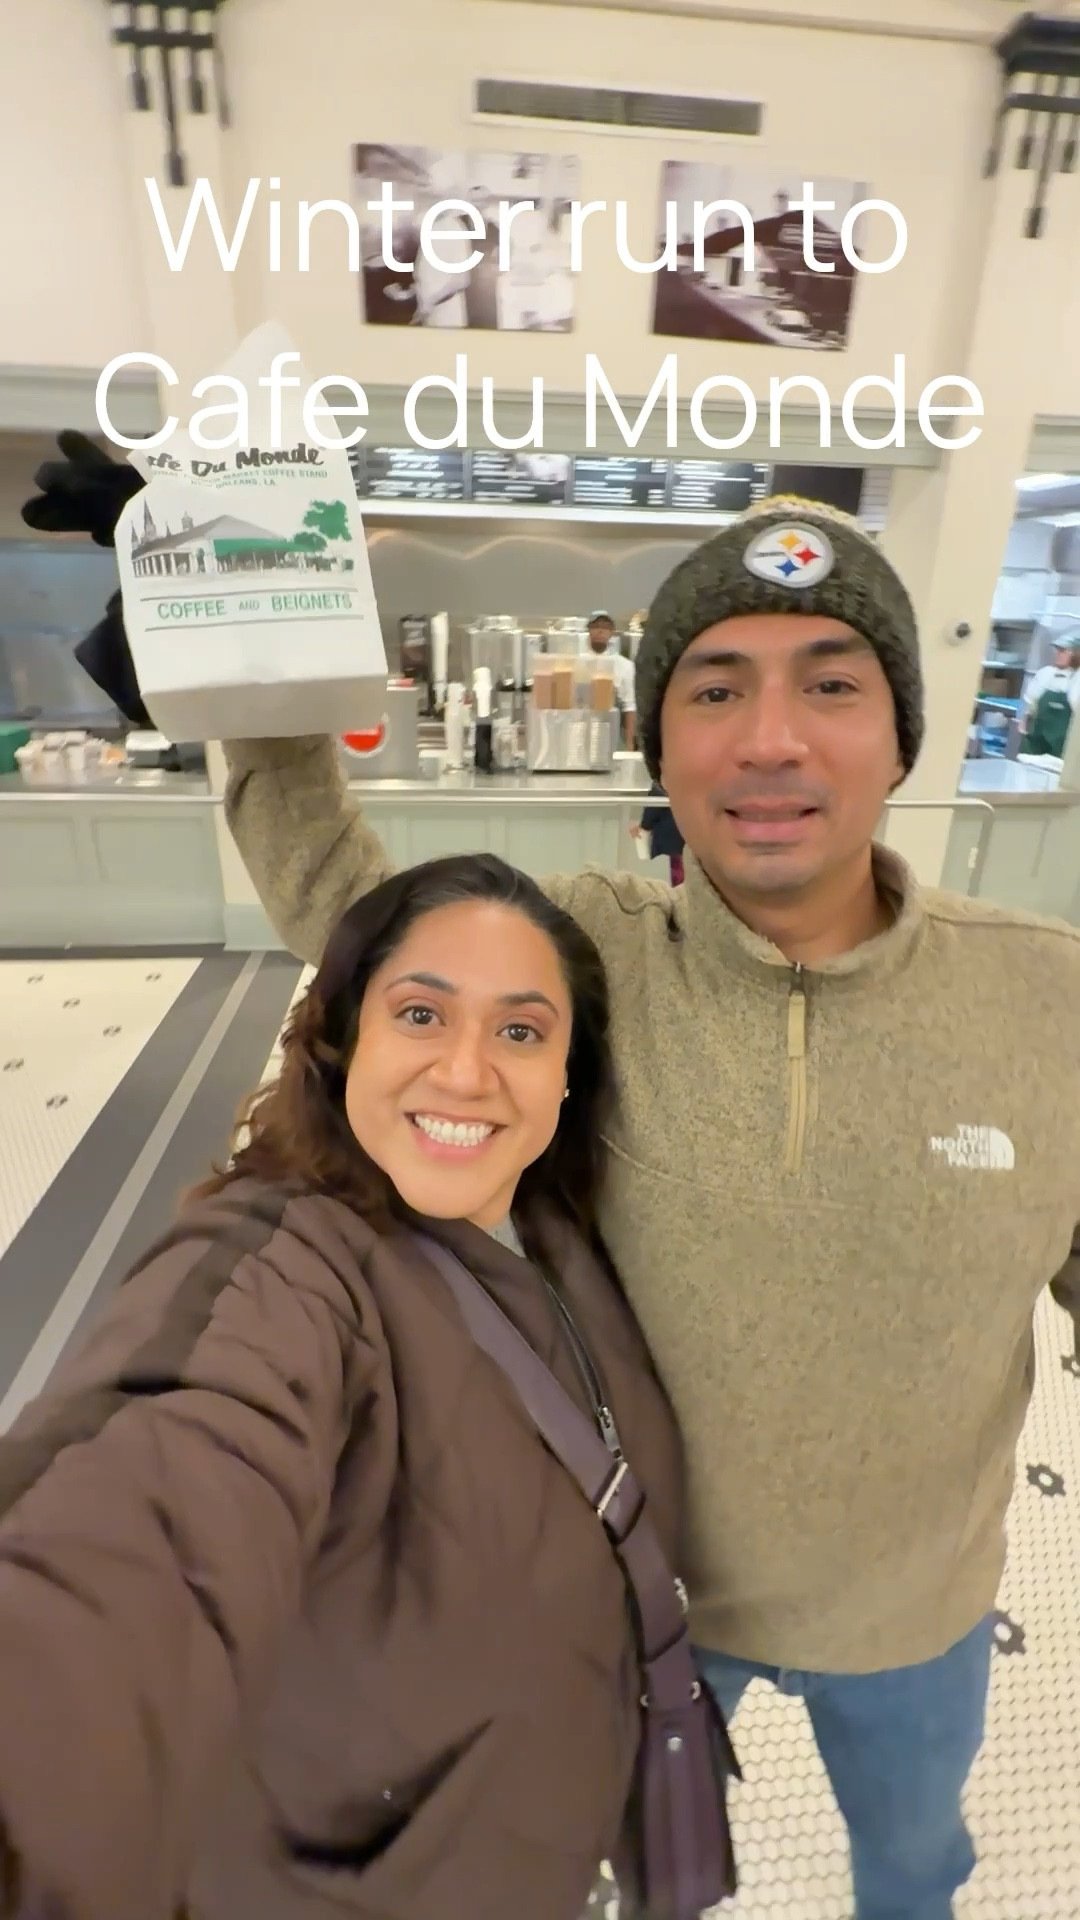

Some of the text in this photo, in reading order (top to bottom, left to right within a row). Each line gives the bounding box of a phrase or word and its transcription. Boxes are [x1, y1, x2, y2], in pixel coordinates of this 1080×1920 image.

[191, 460, 227, 477] Du
[236, 442, 324, 469] Monde
[299, 468, 328, 478] STAND
[157, 592, 353, 620] COFFEE AND BEIGNETS
[956, 1123, 988, 1139] THE
[929, 1136, 988, 1153] NORTH
